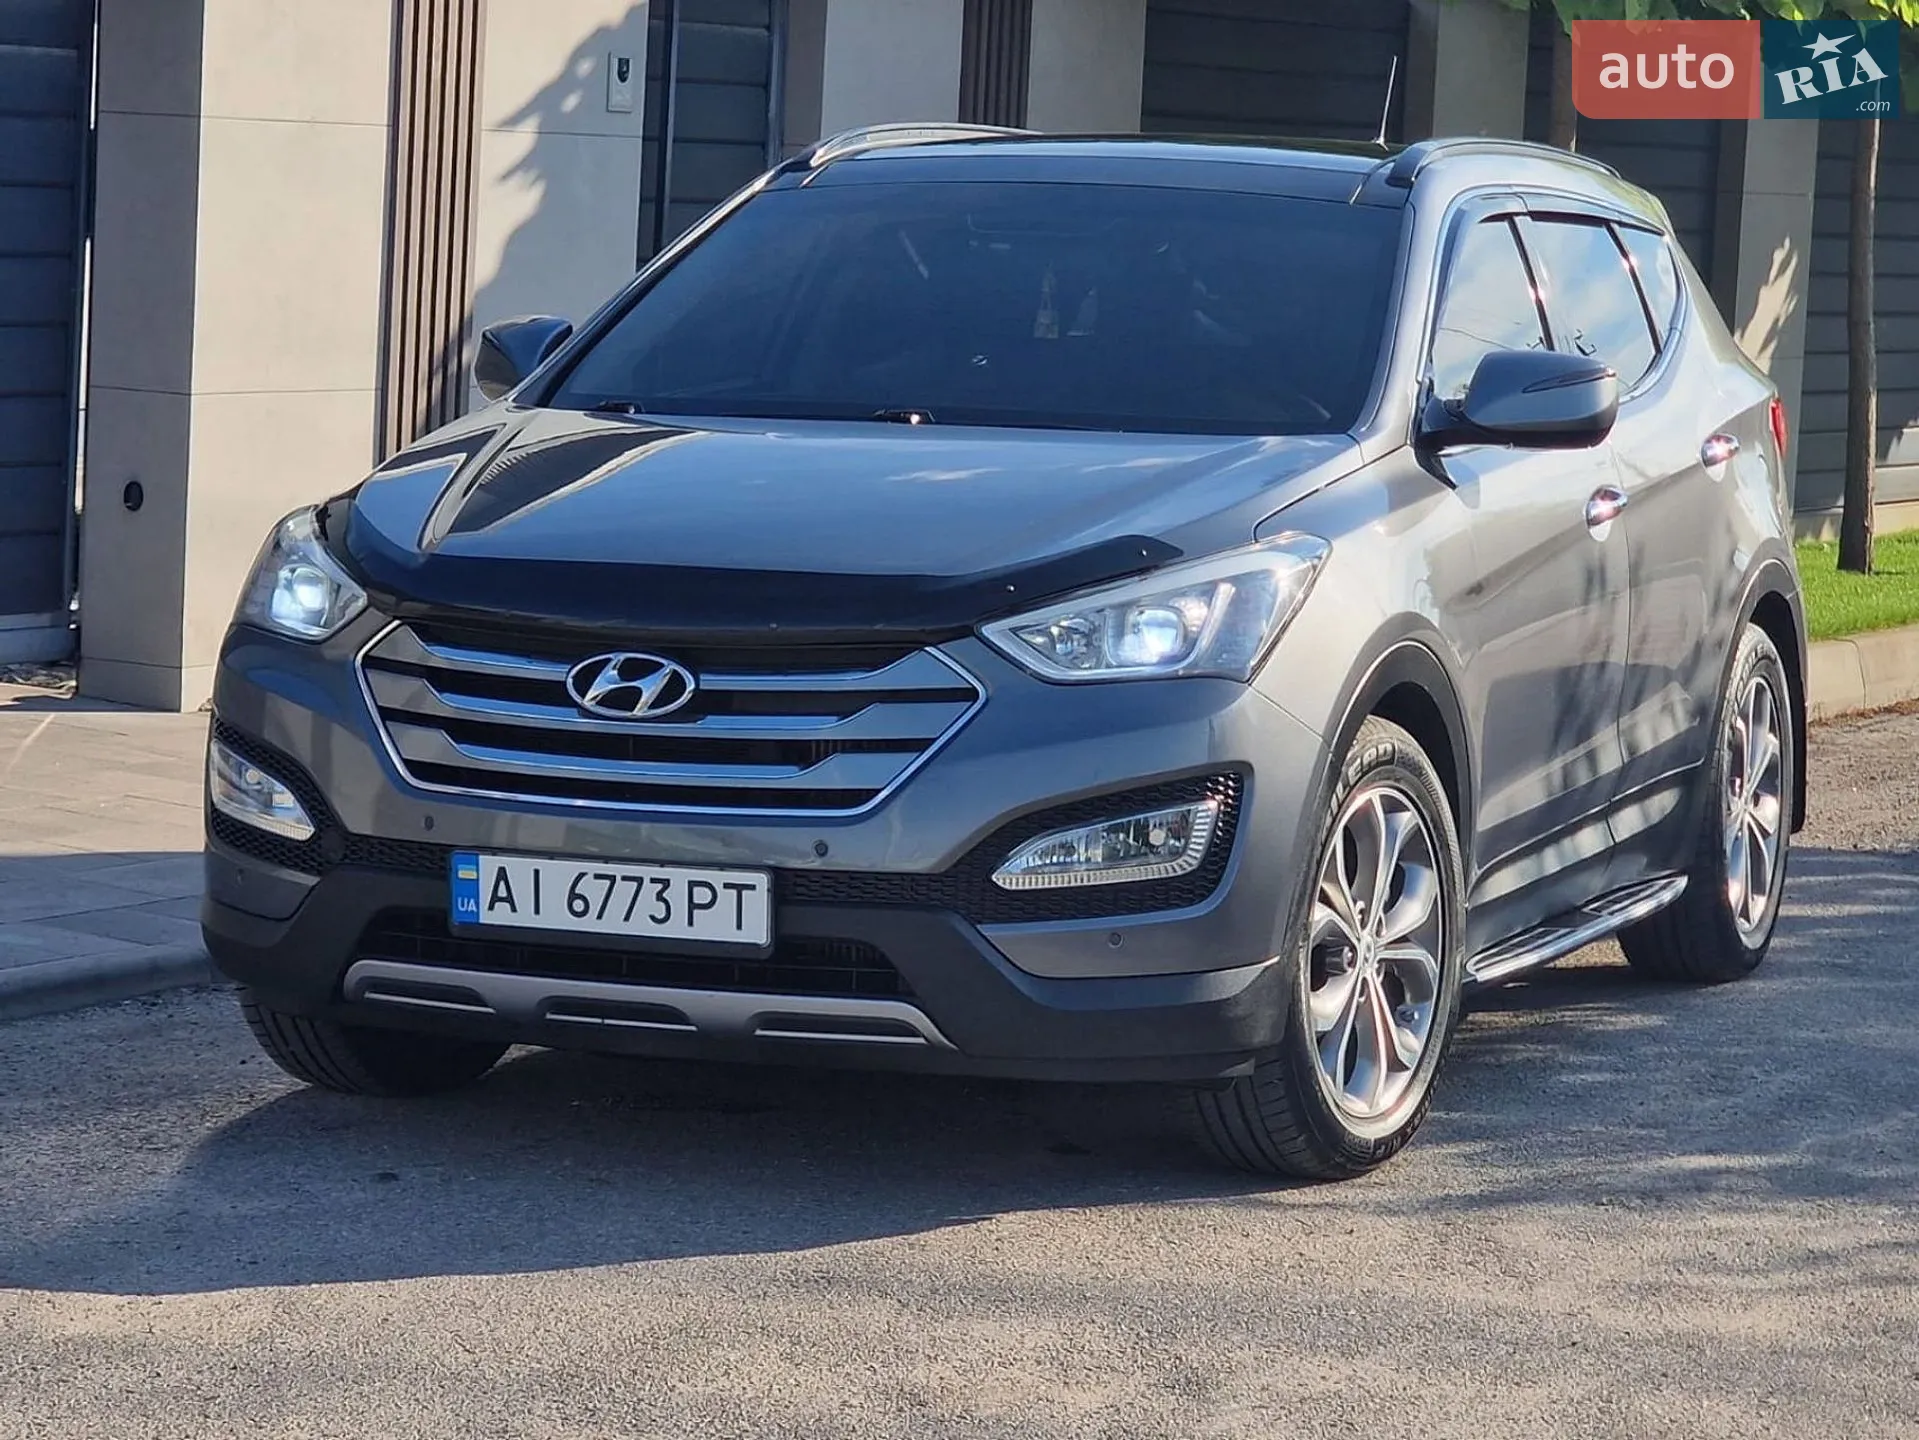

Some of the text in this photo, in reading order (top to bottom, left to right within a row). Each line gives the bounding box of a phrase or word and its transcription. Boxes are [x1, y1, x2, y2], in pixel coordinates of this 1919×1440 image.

[457, 897, 477, 912] UA
[488, 866, 757, 931] AI 6773 PT
